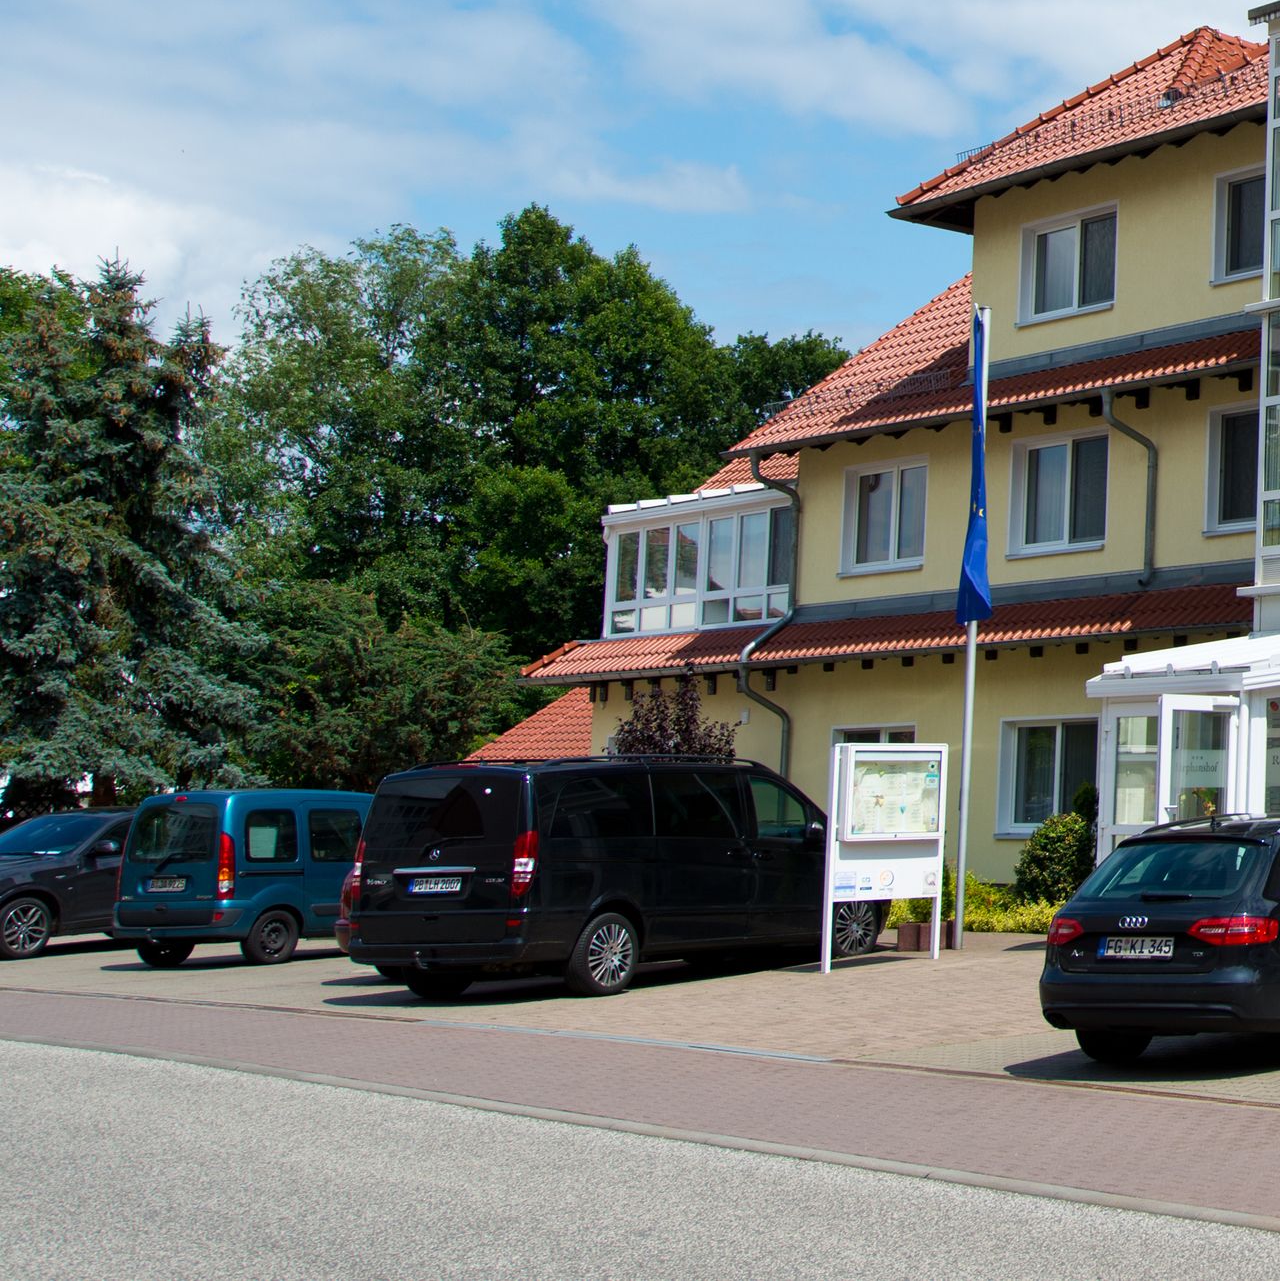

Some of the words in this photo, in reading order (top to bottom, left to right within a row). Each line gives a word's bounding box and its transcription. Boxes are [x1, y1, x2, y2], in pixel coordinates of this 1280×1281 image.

[413, 879, 424, 891] PB
[428, 878, 440, 890] LH
[440, 877, 461, 890] 2007
[1106, 939, 1123, 954] FG
[1129, 938, 1145, 954] KI
[1147, 938, 1173, 954] 345
